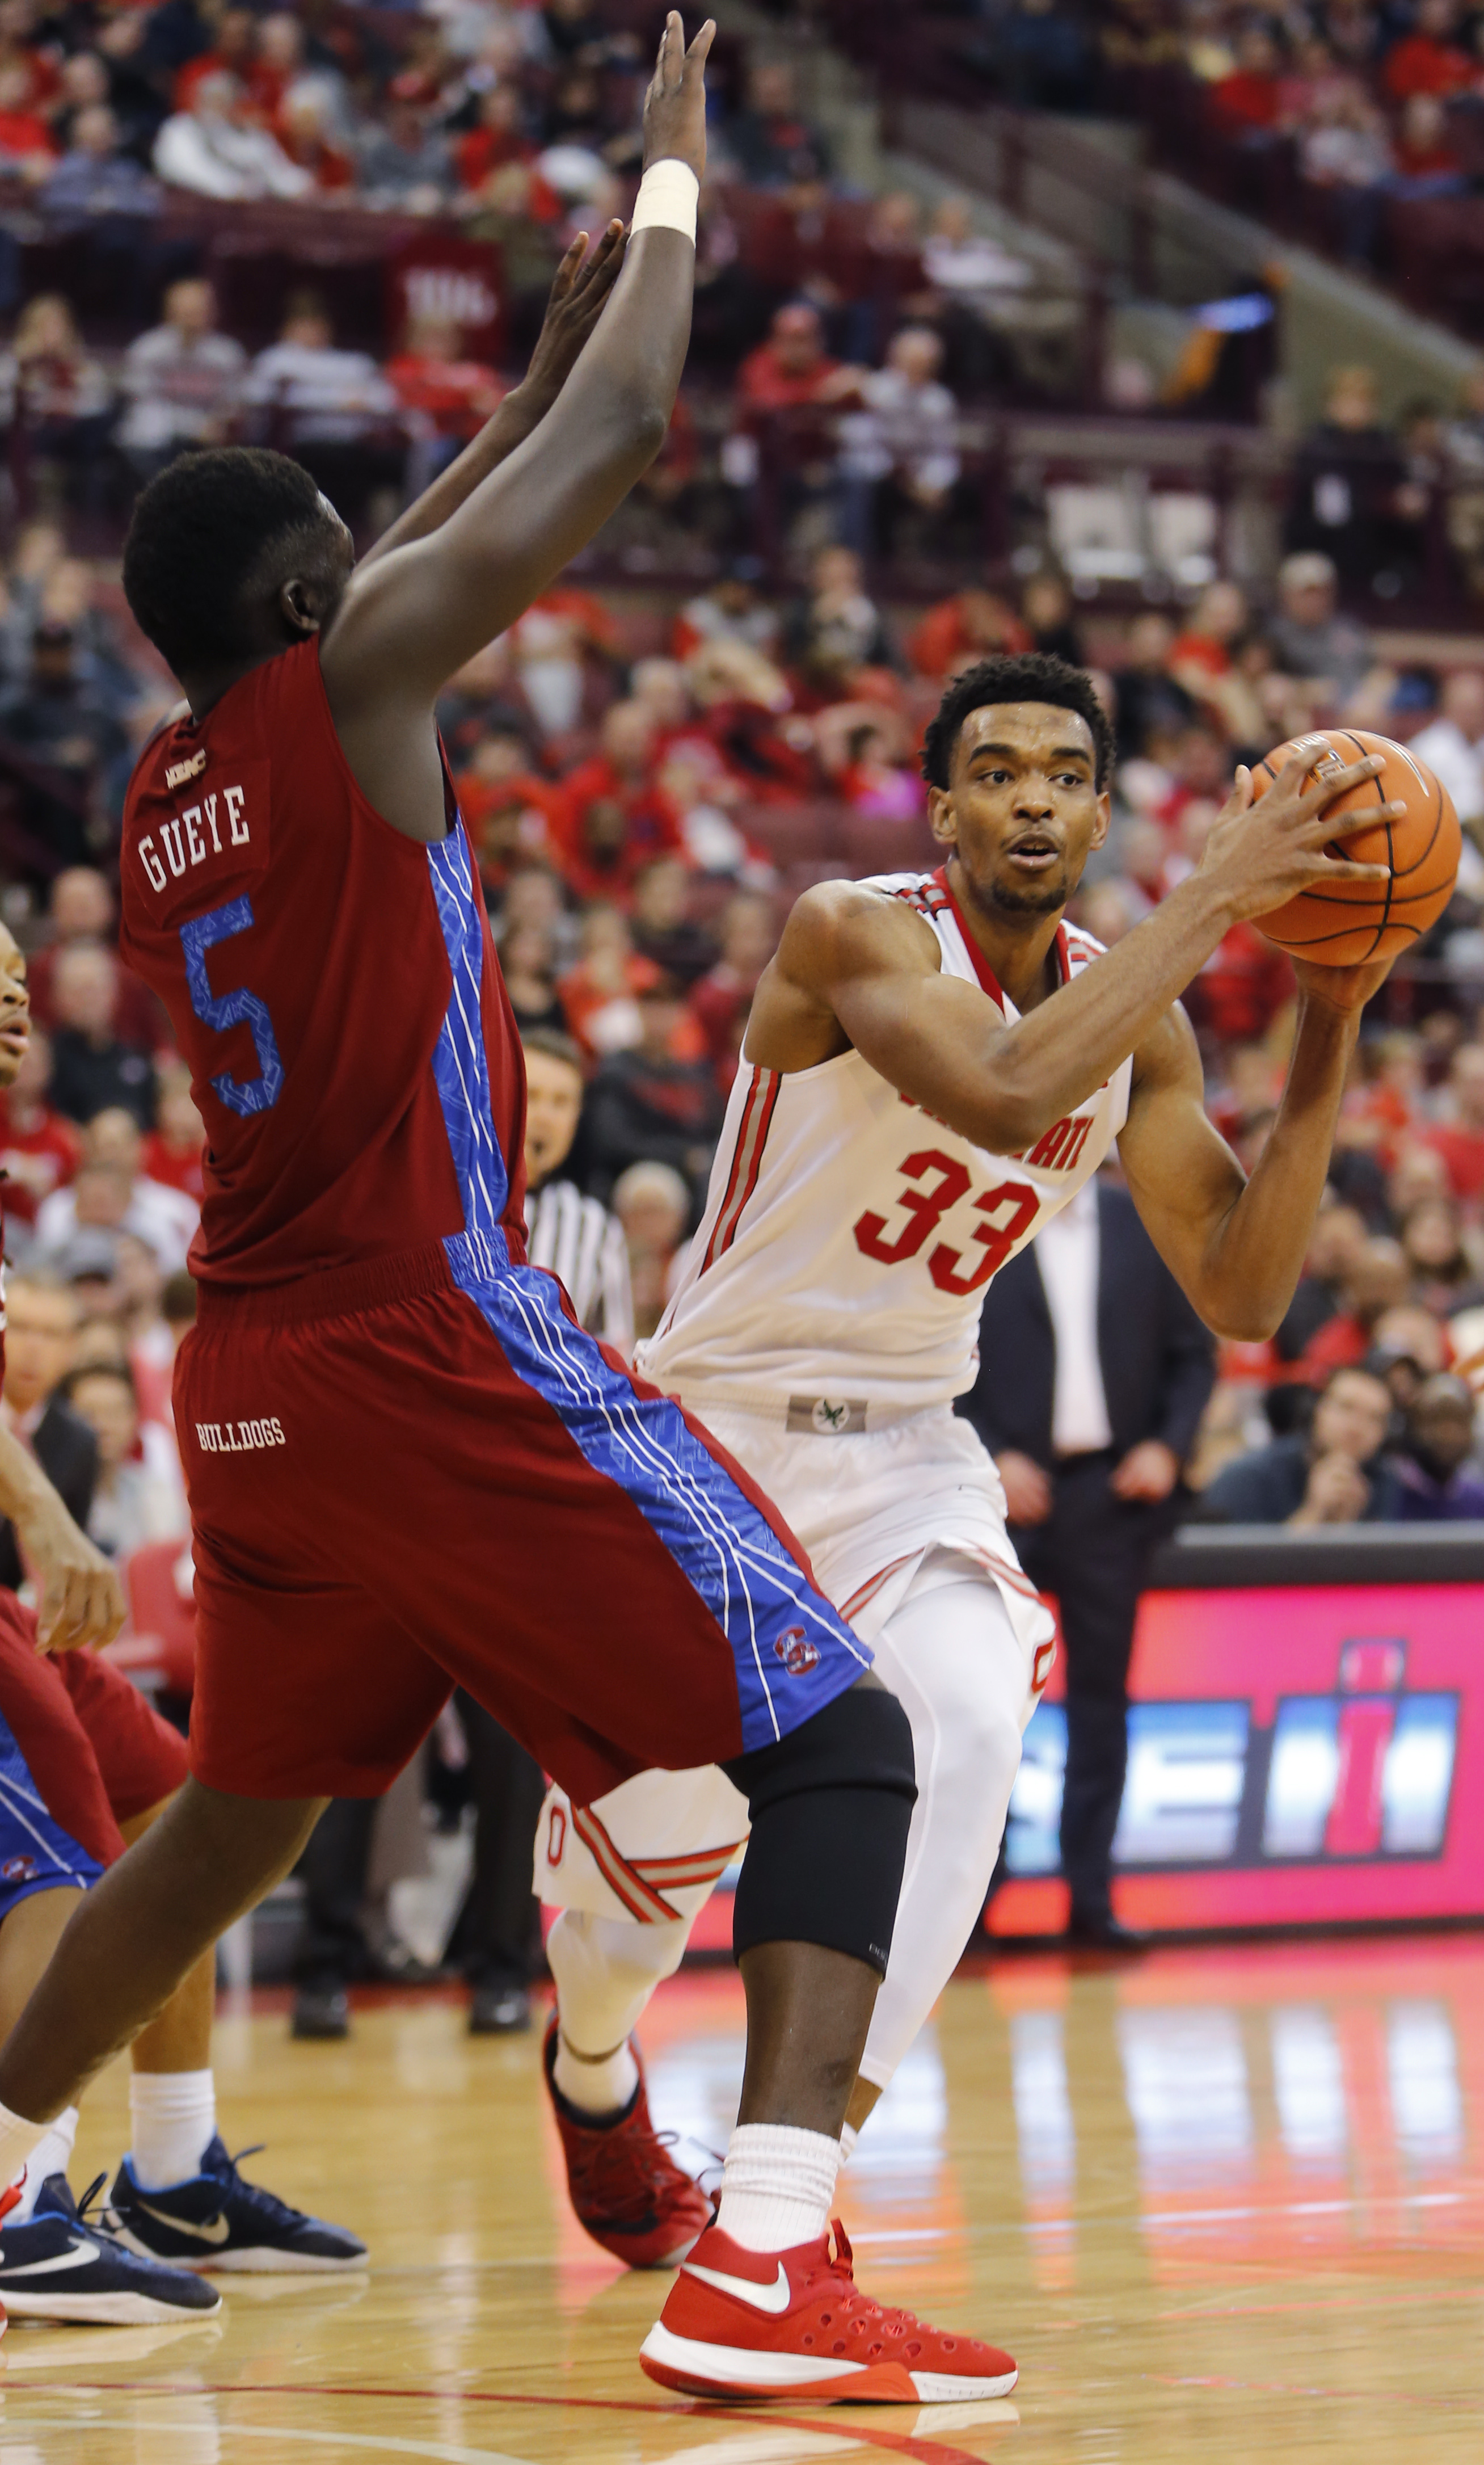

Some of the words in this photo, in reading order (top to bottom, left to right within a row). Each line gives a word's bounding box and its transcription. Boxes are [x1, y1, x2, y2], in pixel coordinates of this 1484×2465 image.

[138, 785, 250, 893] GUEYE
[179, 892, 285, 1118] 5
[853, 1149, 1040, 1296] 33
[195, 1417, 286, 1452] BULLDOGS
